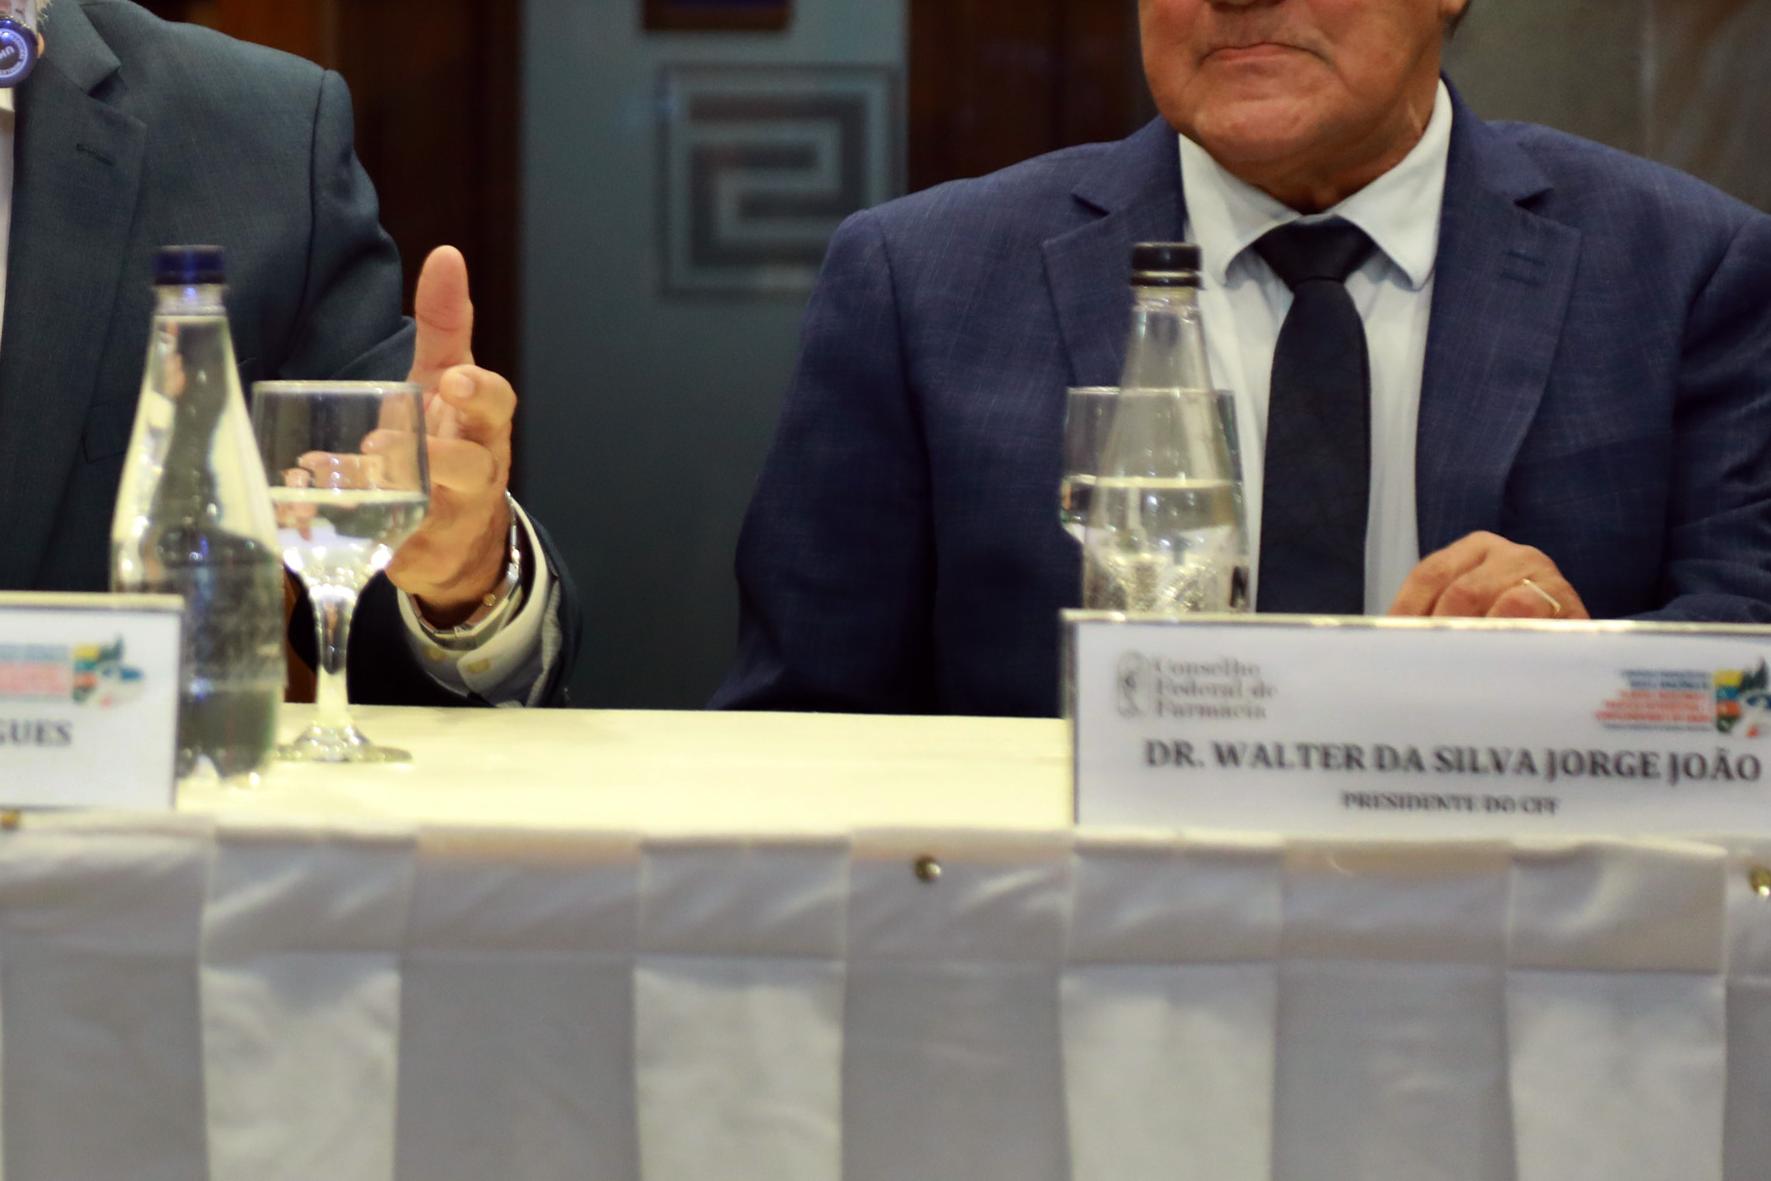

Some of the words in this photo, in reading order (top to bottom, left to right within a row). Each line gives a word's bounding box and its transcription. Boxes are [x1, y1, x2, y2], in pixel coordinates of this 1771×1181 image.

[1145, 738, 1205, 769] DR.
[1211, 740, 1366, 772] WALTER
[1373, 743, 1426, 773] DA
[1433, 745, 1538, 777] SILVA
[1544, 747, 1662, 782] JORGE
[1668, 746, 1763, 786] JOÃO
[1343, 790, 1474, 811] PRESIDENTE
[1484, 794, 1516, 814] DO
